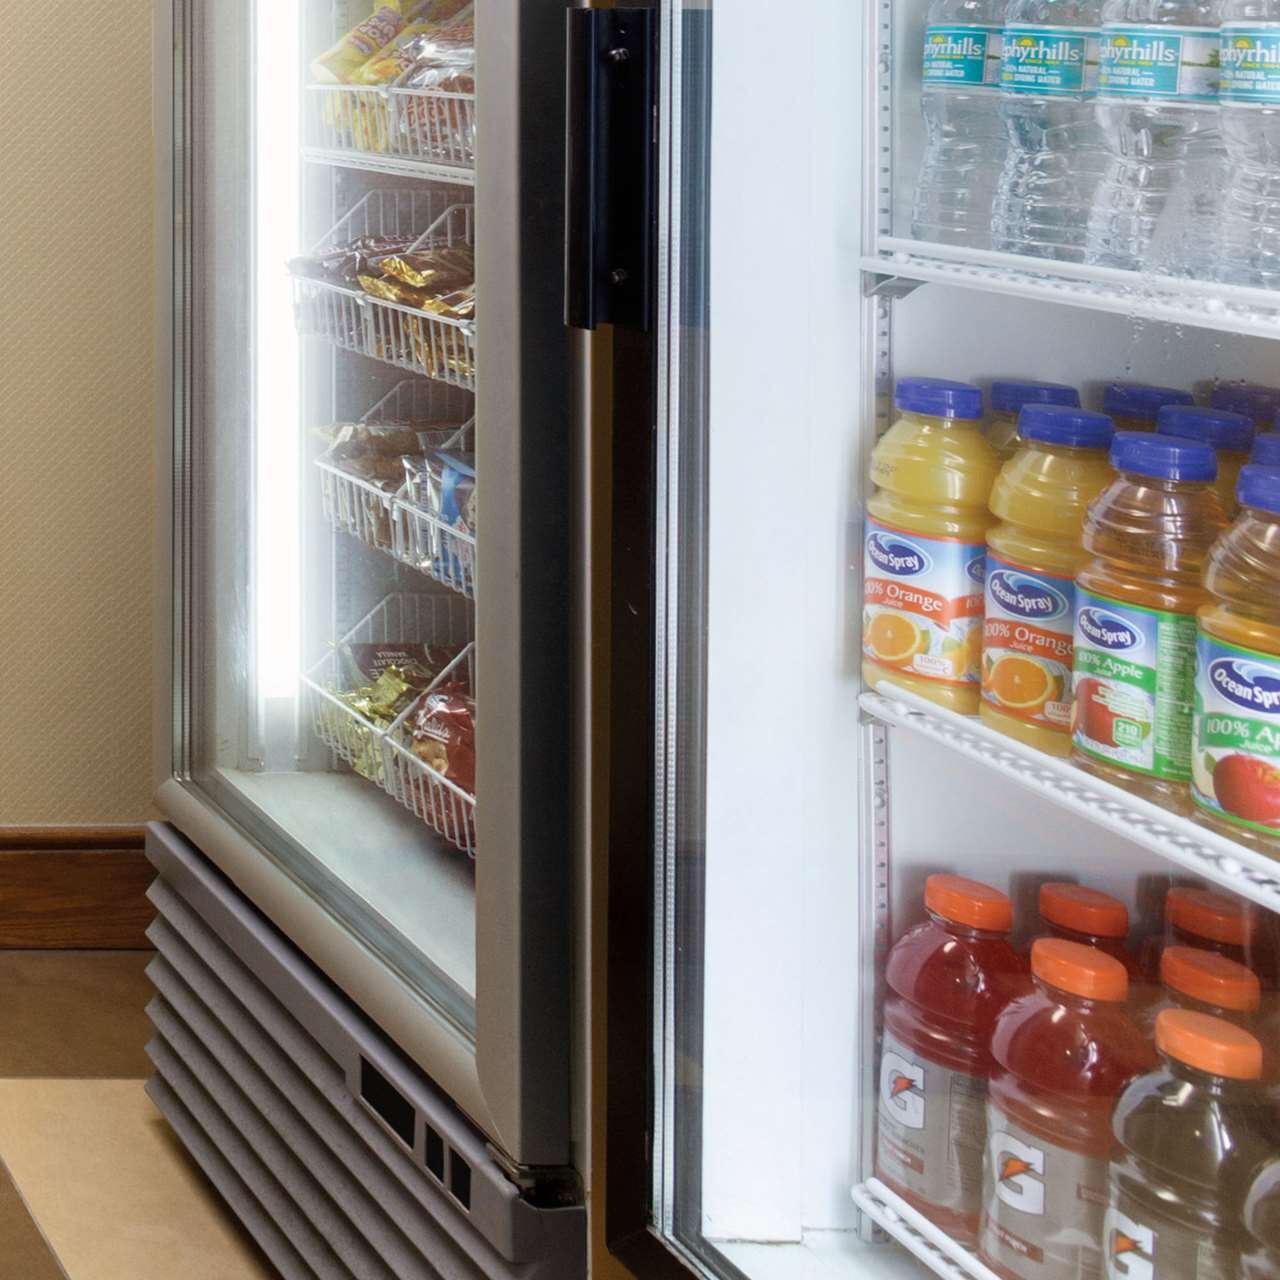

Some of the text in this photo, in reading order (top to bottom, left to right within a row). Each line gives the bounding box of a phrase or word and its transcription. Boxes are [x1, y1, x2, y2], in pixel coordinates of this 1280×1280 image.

[889, 554, 920, 571] Spray
[883, 596, 904, 609] Juice
[887, 584, 944, 612] Orange
[991, 579, 1018, 606] Ocean
[1017, 594, 1054, 613] Spray
[1080, 614, 1132, 645] Ocean Spray
[1008, 640, 1034, 653] Juice
[1103, 658, 1145, 680] Apple
[1213, 667, 1280, 710] Ocean Spr
[1207, 718, 1251, 738] 100%
[1240, 738, 1273, 753] Juice
[880, 1050, 926, 1130] G
[990, 1131, 1045, 1216] G
